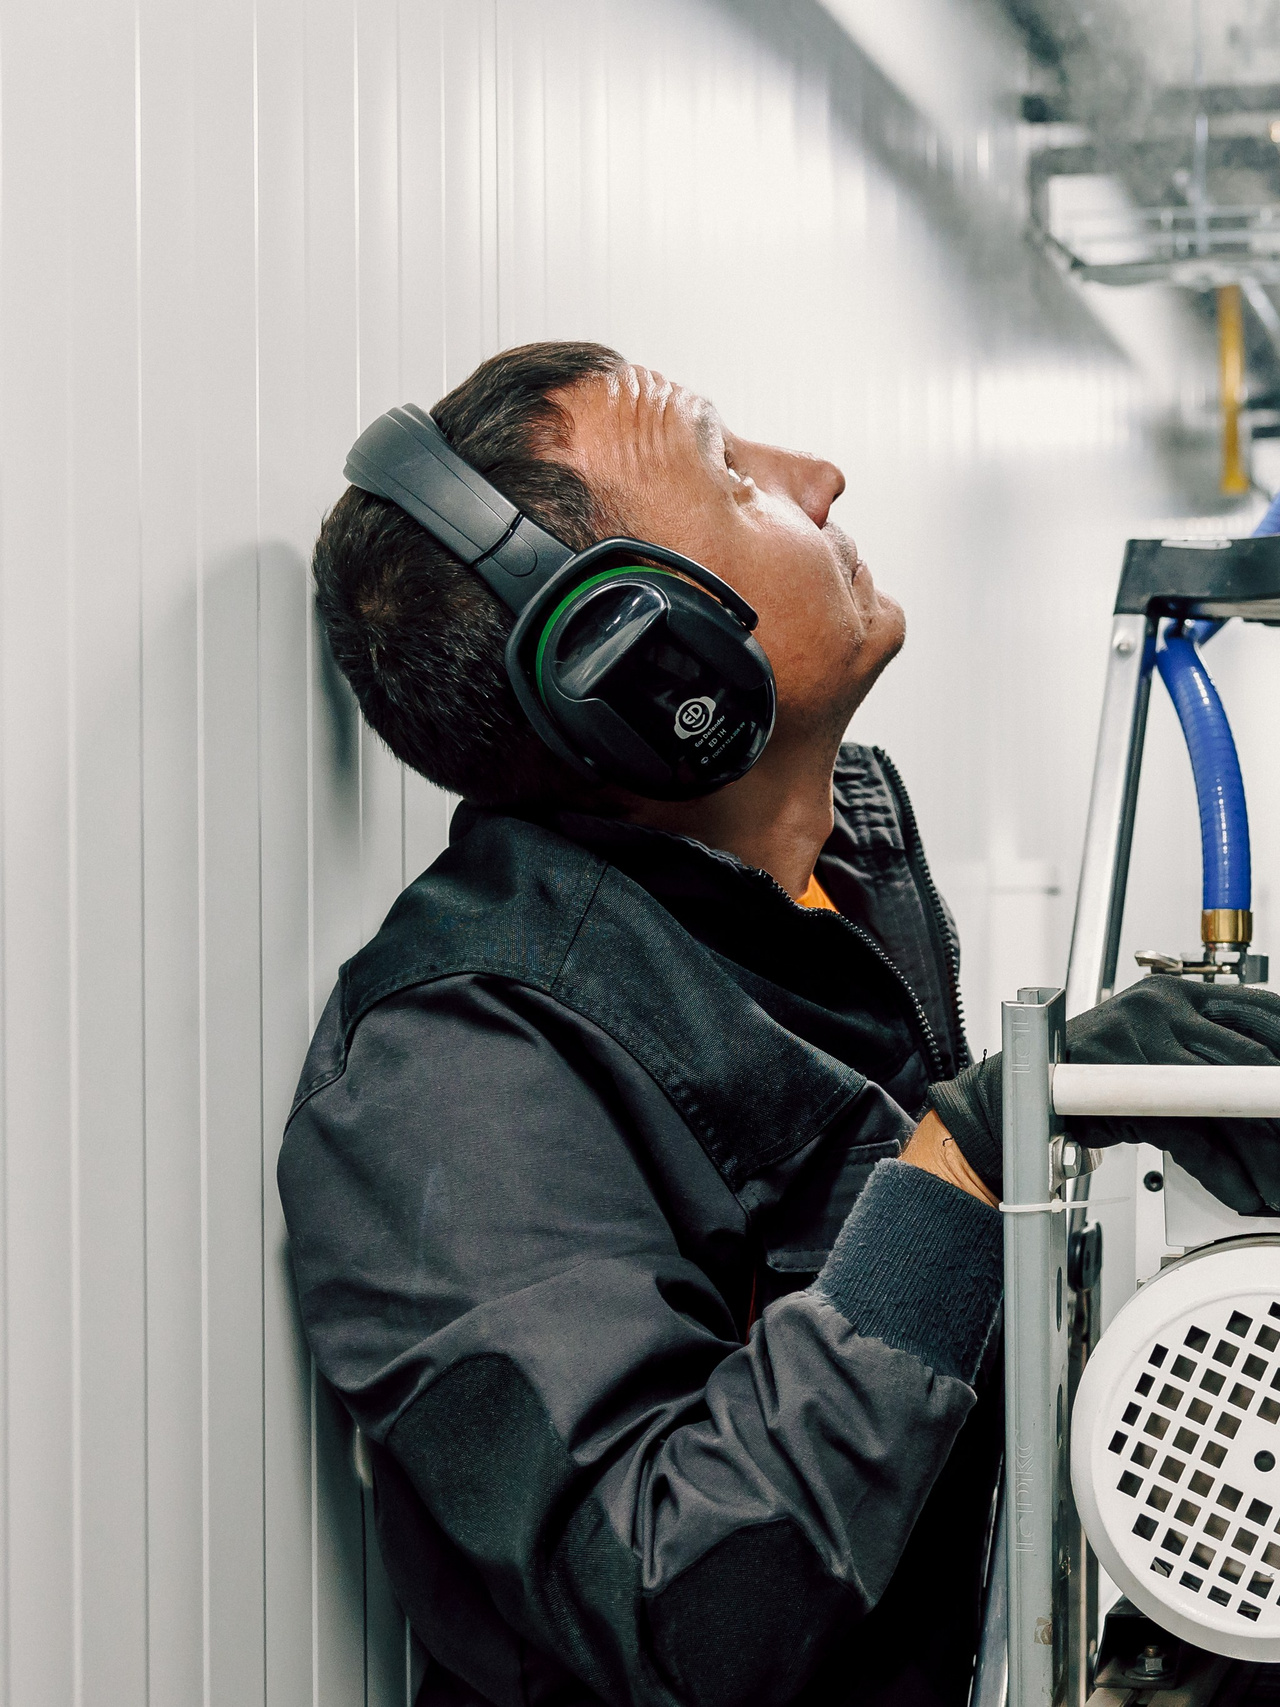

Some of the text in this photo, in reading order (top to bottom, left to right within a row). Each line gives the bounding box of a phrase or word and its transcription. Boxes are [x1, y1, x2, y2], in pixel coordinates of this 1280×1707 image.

[682, 703, 703, 725] ED
[702, 715, 726, 739] Defender
[708, 737, 718, 748] ED
